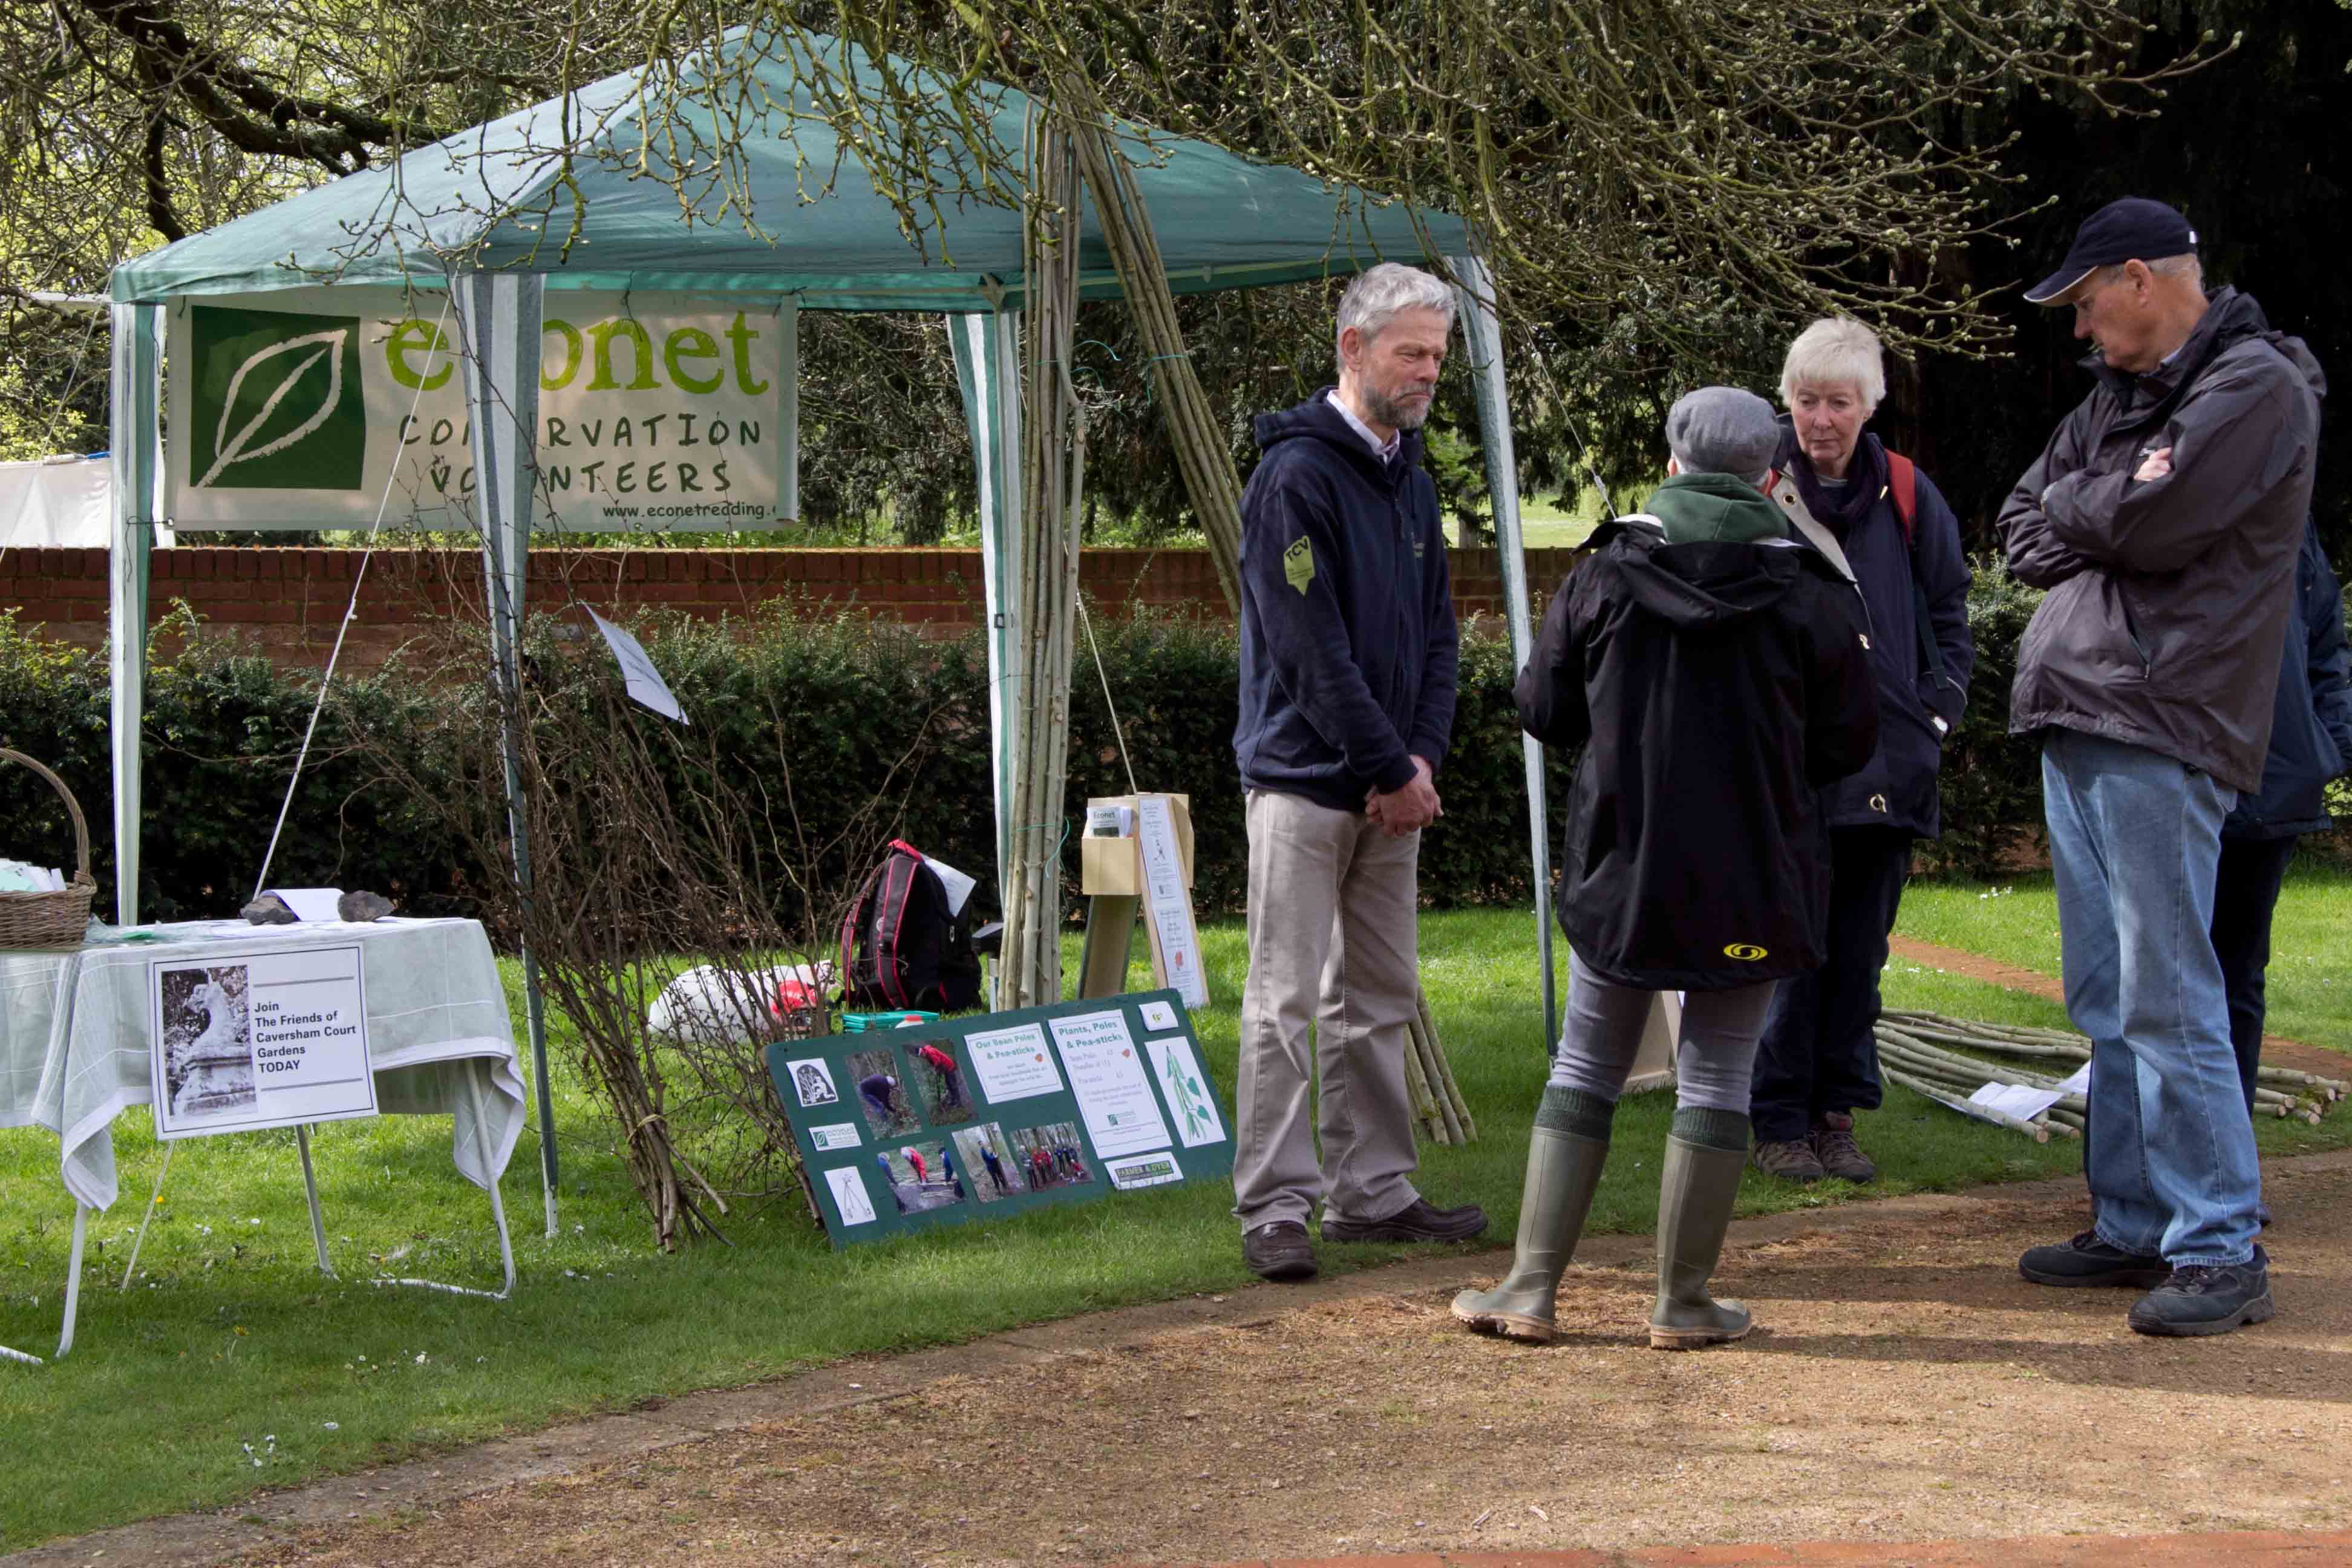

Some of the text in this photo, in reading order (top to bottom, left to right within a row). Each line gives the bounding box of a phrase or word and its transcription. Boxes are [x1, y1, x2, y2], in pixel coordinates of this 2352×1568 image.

[385, 310, 769, 395] eonet
[399, 413, 760, 447] CORVATION
[430, 460, 731, 493] VONTEERS
[1285, 538, 1309, 562] TCV
[255, 1001, 279, 1013] Join
[255, 1010, 338, 1028] The Friends of
[256, 1025, 356, 1043] Caversham Court
[1059, 1021, 1119, 1036] Plants, Poles
[976, 1033, 1036, 1049] Our Bean Poles
[1076, 1034, 1123, 1048] Pea-sticks
[258, 1046, 305, 1058] Gardens
[995, 1046, 1036, 1059] Pea-sticks
[258, 1059, 301, 1074] TODAY
